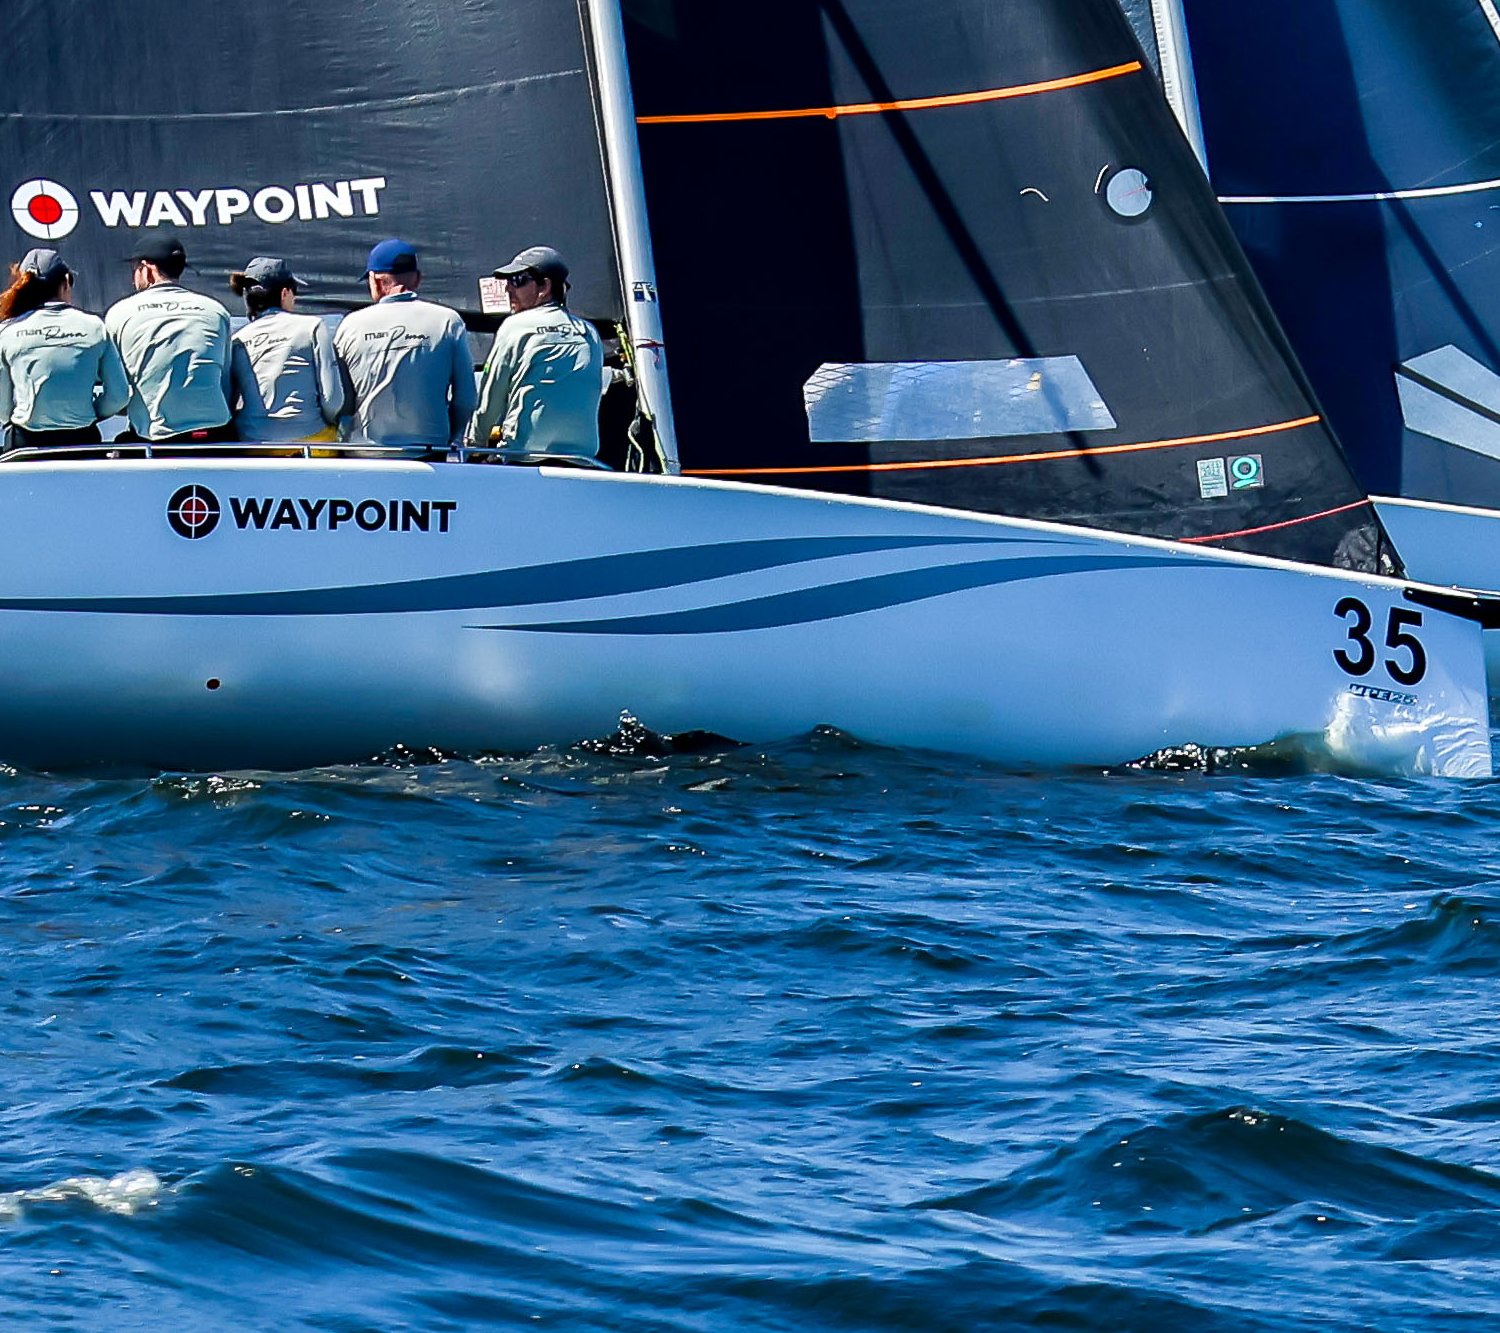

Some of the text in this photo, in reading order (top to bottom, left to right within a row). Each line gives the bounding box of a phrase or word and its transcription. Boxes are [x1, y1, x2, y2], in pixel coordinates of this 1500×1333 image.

[90, 177, 386, 227] WAYPOINT
[229, 498, 458, 533] WAYPOINT
[1333, 596, 1427, 686] 35
